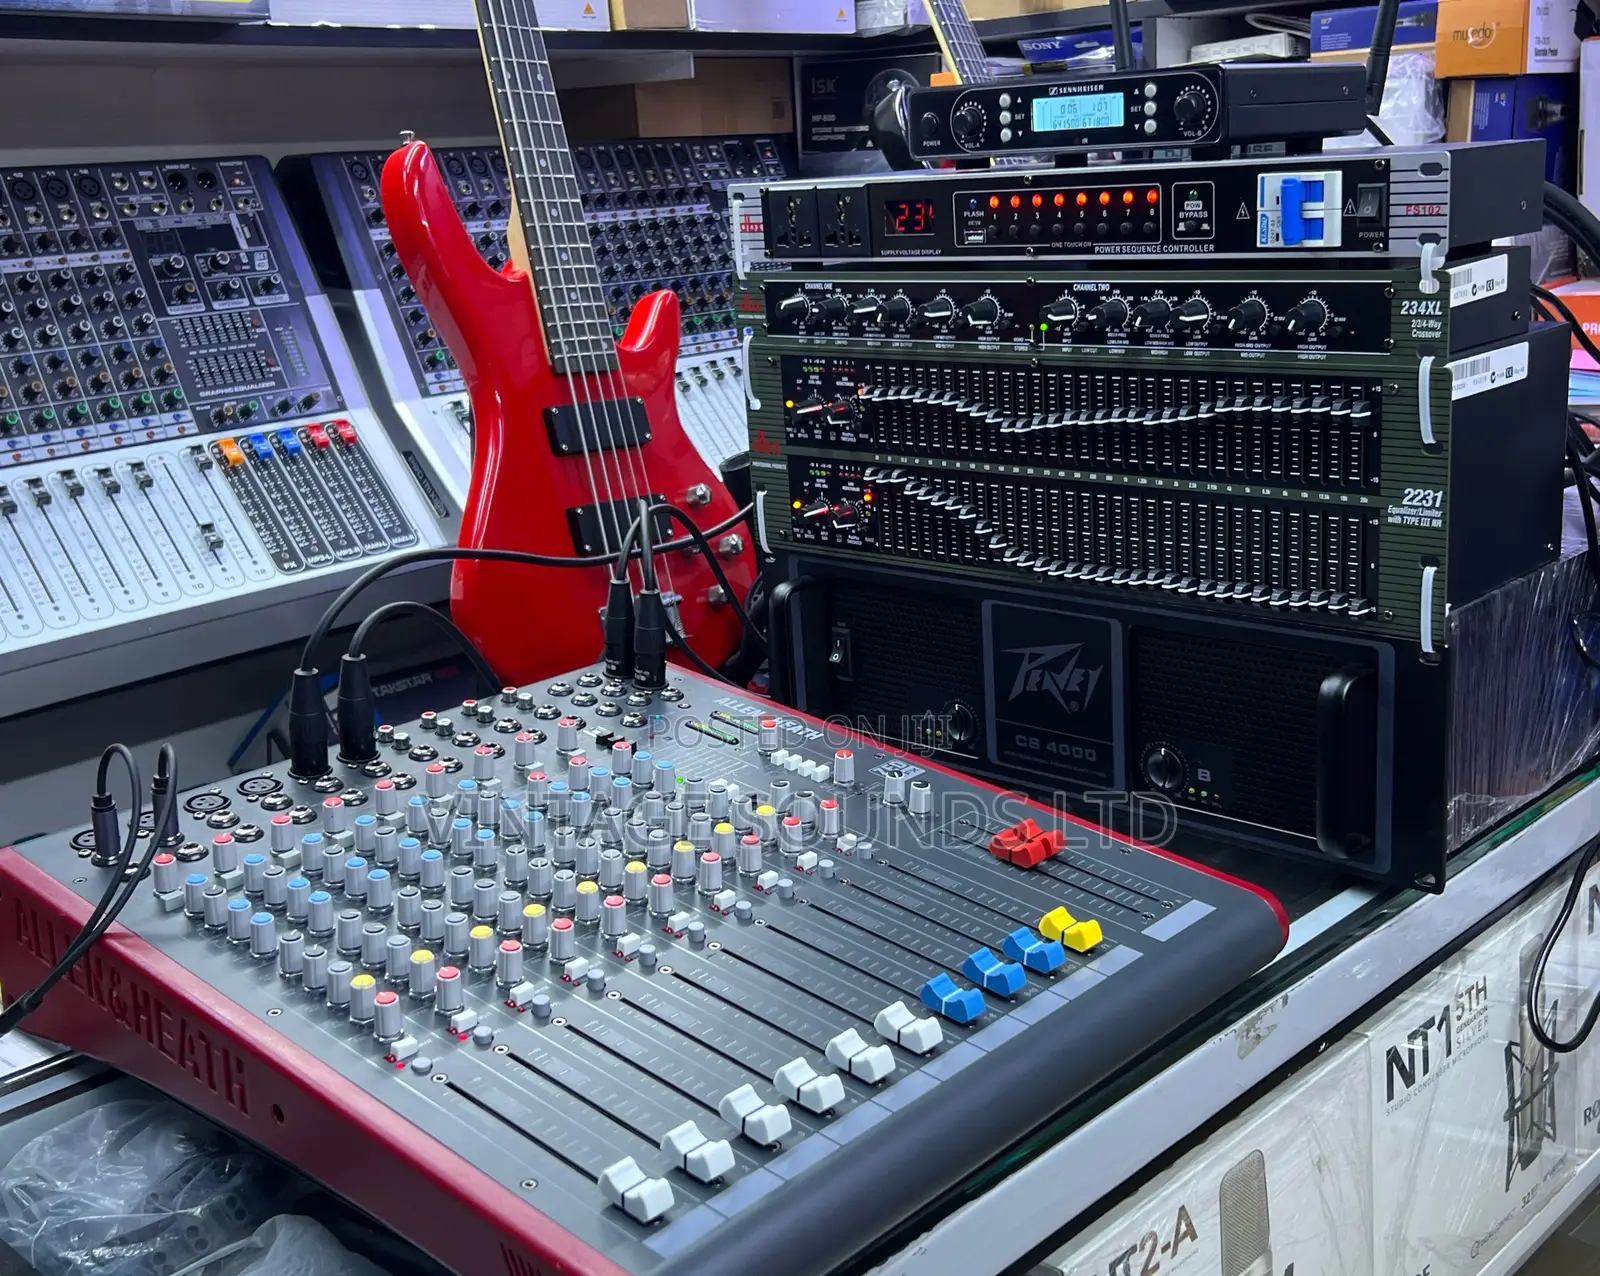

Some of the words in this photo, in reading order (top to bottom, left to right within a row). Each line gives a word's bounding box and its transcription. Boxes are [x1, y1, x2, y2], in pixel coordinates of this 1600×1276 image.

[1022, 41, 1062, 51] SONY
[811, 77, 836, 94] ISK
[1059, 84, 1104, 94] SENNHEISER
[1056, 211, 1062, 219] 4
[1079, 210, 1084, 218] 5
[1102, 209, 1107, 217] 6
[1150, 208, 1155, 216] 8
[1179, 210, 1208, 218] BYPASS
[1405, 205, 1442, 216] FS102
[1358, 231, 1385, 239] POWER
[1094, 245, 1121, 254] POWER
[1121, 245, 1162, 254] SEQUENCE
[1162, 244, 1215, 253] CONTROLLER
[804, 282, 822, 290] CHANNEL
[1073, 283, 1097, 291] CHANNEL
[1400, 300, 1443, 316] 234XL
[1411, 319, 1442, 330] 2/3/4-Way
[1411, 328, 1442, 339] Crossover
[233, 381, 276, 393] EQUALIZER
[1402, 488, 1443, 508] 2231
[1402, 516, 1420, 526] TYPE
[1420, 517, 1431, 527] III
[283, 561, 298, 570] FX
[191, 582, 205, 591] 10
[371, 671, 434, 699] TAKSTAR
[712, 696, 767, 718] ALLEN
[1015, 734, 1041, 751] CS
[1046, 741, 1097, 762] 4000
[873, 761, 908, 777] ZED
[1197, 768, 1211, 782] B
[1455, 975, 1487, 1021] 5TH
[1456, 1004, 1488, 1034] GENERATION
[1456, 1015, 1489, 1050] SILVER
[1385, 1003, 1453, 1104] NT1
[1385, 1094, 1411, 1117] STUDIO
[1413, 1064, 1451, 1097] CONDENSER
[1451, 1031, 1489, 1067] MICROPHONE
